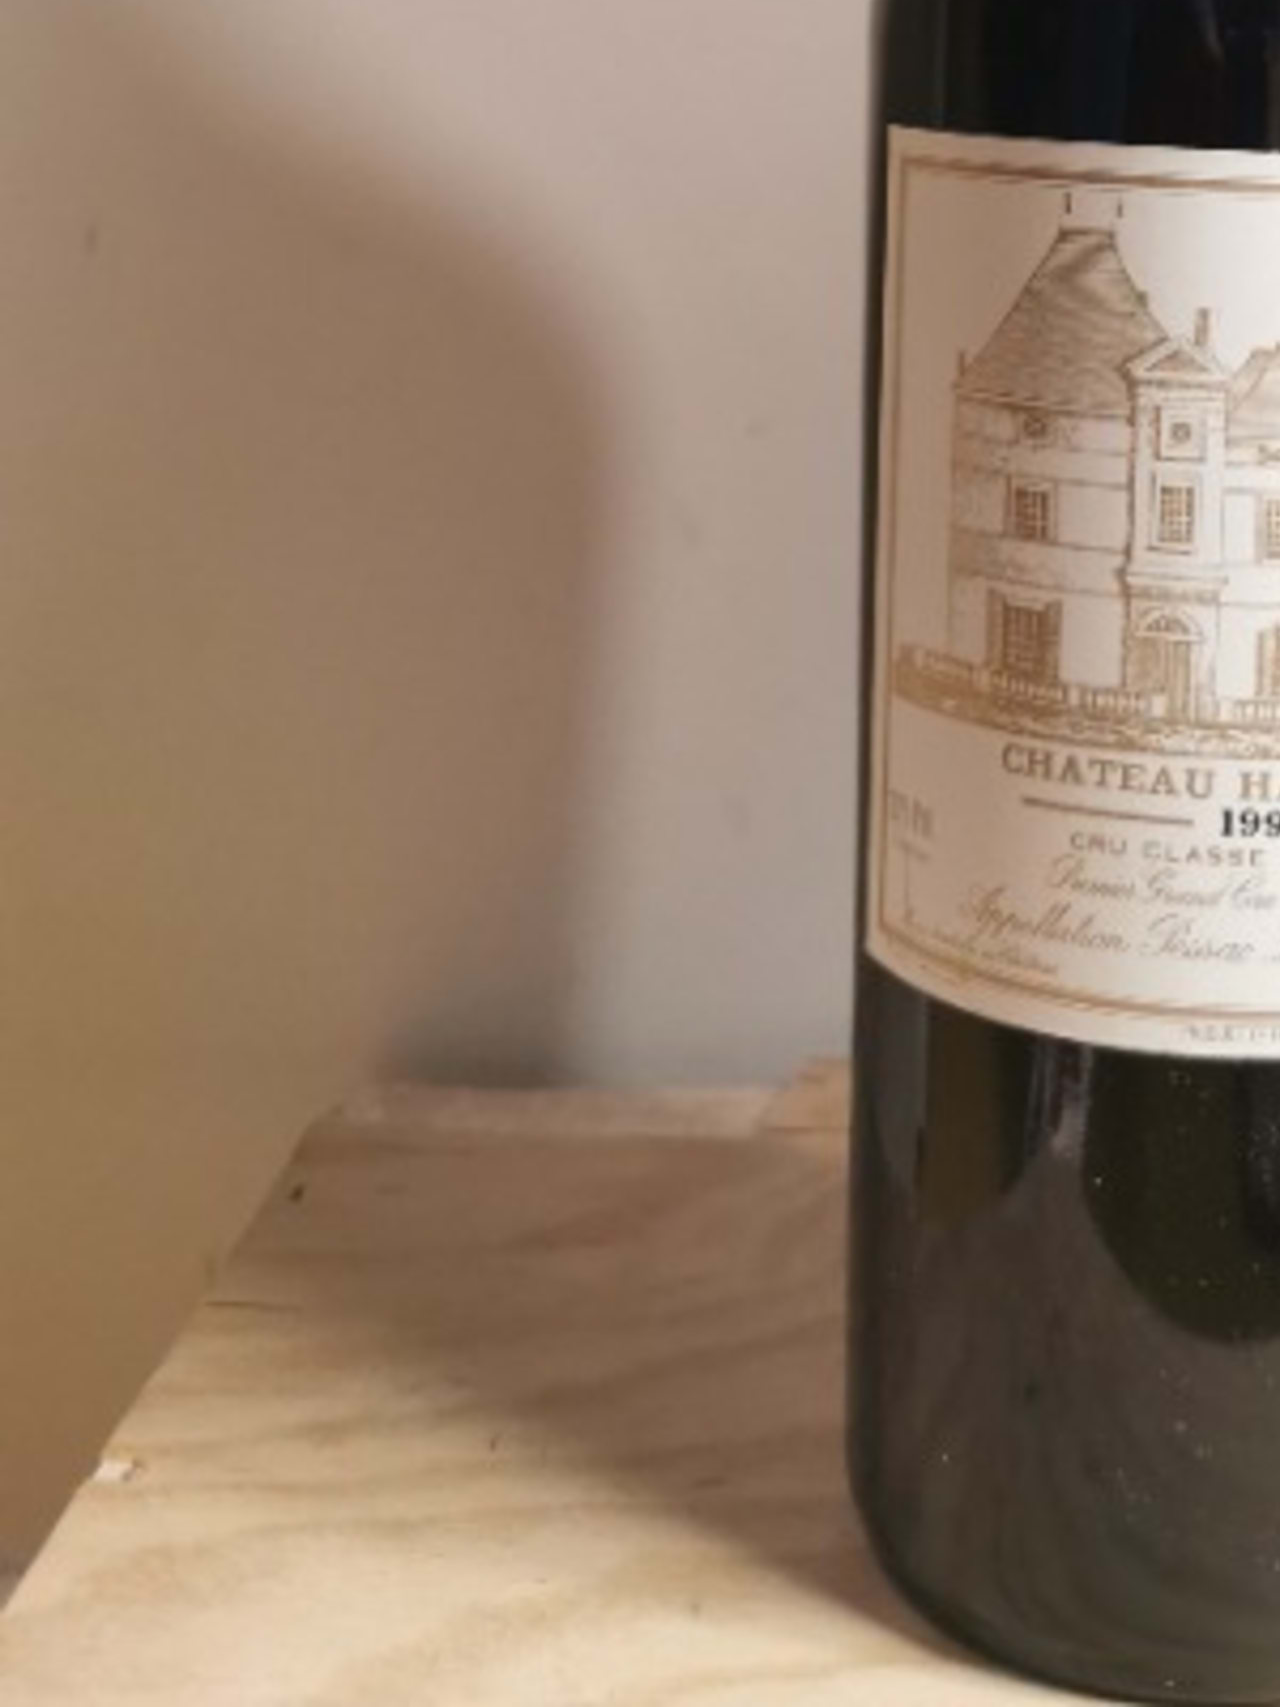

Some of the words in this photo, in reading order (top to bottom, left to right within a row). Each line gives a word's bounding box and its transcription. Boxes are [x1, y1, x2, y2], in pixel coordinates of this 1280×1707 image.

[1001, 742, 1215, 800] CHATEAU
[1069, 831, 1128, 856] CRU
[1141, 839, 1264, 869] CLASSE
